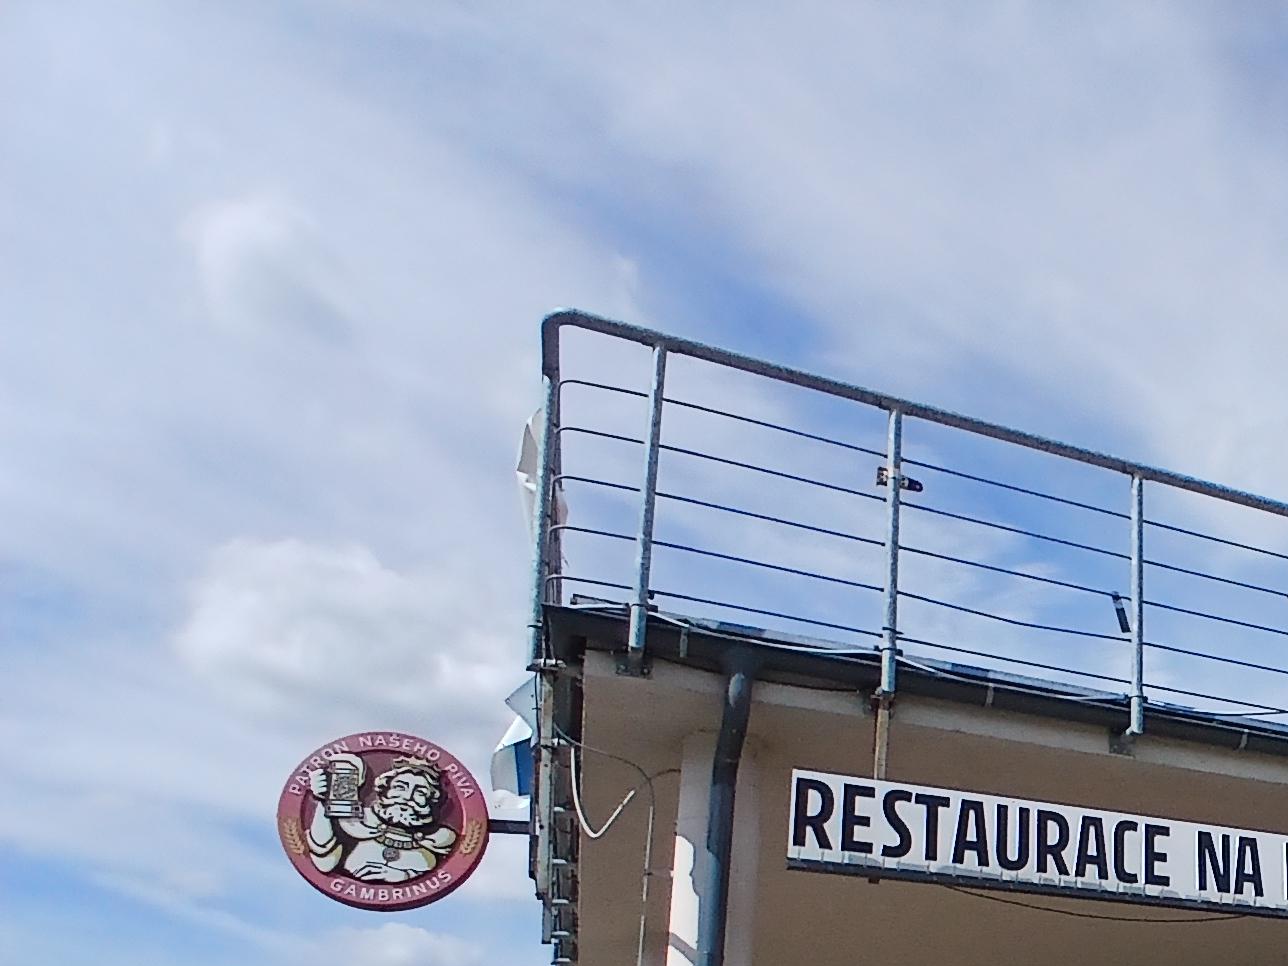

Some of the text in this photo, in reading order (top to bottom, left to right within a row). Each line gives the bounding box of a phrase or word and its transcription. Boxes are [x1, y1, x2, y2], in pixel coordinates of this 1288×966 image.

[358, 733, 441, 763] NAŠEHO
[444, 762, 476, 799] PIVA
[791, 777, 1171, 888] RESTAURACE
[1196, 829, 1265, 898] NA
[330, 869, 453, 902] GAMBRINUS
